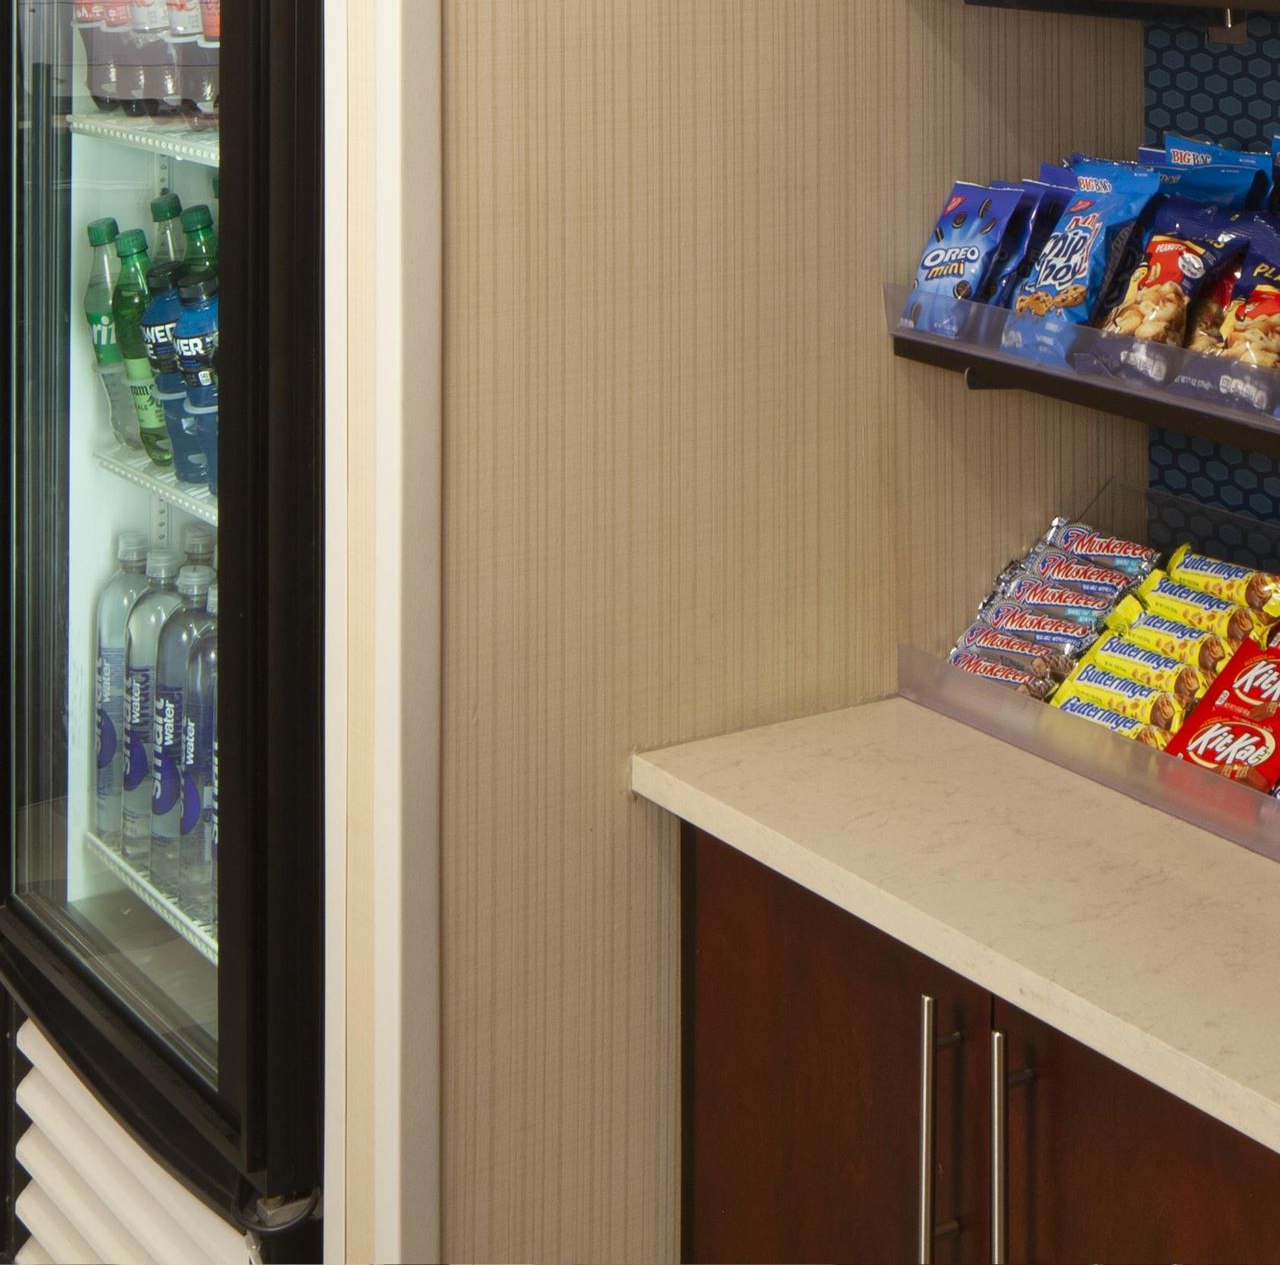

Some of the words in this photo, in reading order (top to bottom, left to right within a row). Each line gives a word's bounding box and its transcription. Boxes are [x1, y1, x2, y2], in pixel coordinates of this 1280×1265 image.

[922, 246, 979, 268] OREO
[925, 260, 964, 281] mini
[1177, 552, 1254, 580] Butterfinger
[1025, 582, 1109, 610] Musketeers
[1153, 578, 1232, 611] Butterfinger
[1004, 607, 1090, 637] Musketeers
[1100, 635, 1181, 671] Butterfinger
[101, 660, 112, 703] water
[1076, 663, 1156, 699] Butterfinger
[131, 678, 141, 725] water
[164, 699, 176, 747] water
[185, 718, 196, 765] water
